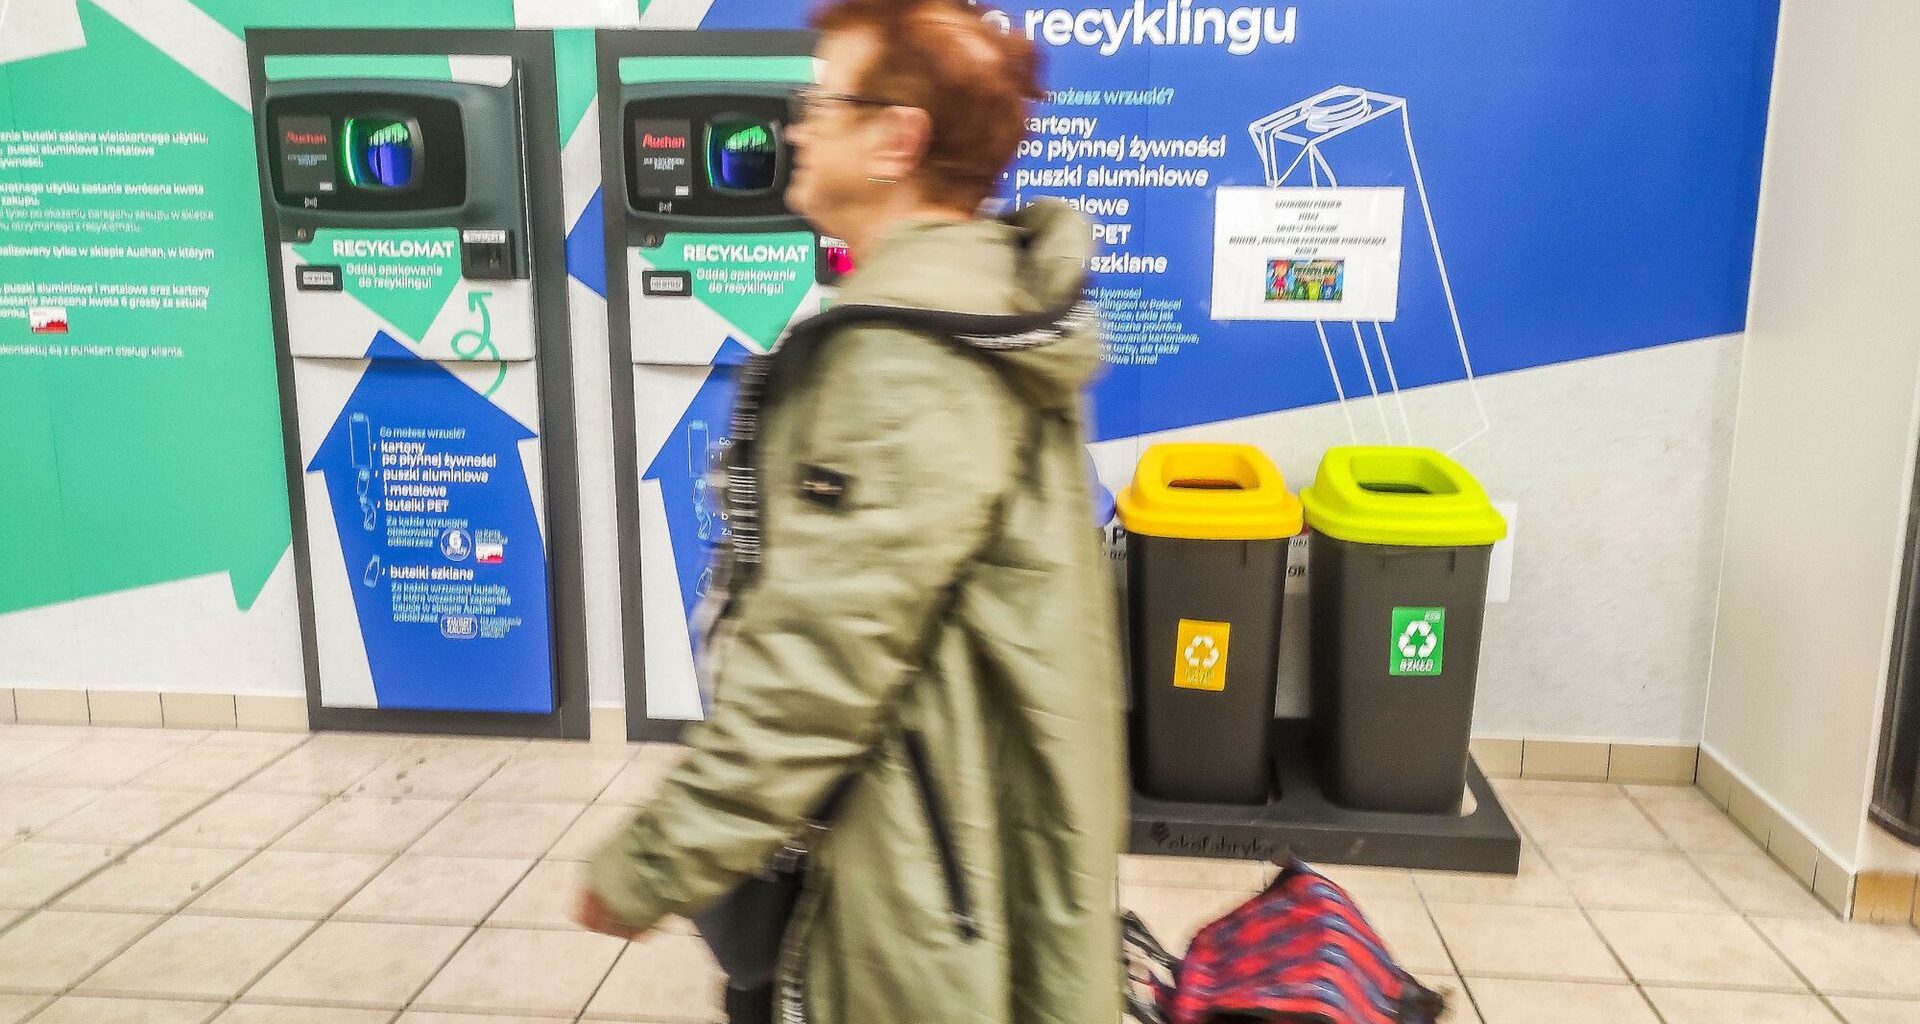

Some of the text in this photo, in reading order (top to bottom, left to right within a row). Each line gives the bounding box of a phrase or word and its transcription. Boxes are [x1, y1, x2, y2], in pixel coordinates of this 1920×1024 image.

[1025, 0, 1298, 56] recyklingu
[1103, 87, 1175, 106] wrzucić?
[642, 133, 686, 149] Auchan
[1016, 134, 1227, 162] po płynnej żywności
[1016, 163, 1210, 190] puszki aluminiowe
[1091, 223, 1131, 245] PET
[333, 239, 455, 259] RECYKLOMAT
[683, 244, 809, 263] RECYKLOMAT
[378, 262, 443, 278] opakowanie
[1090, 252, 1168, 274] szklane
[696, 267, 796, 284] Oddaj opakowanie
[708, 280, 723, 294] do
[381, 440, 426, 456] kartony
[399, 452, 442, 470] płynnej
[443, 452, 497, 469] żywności
[383, 467, 490, 484] puszki aluminiowe
[390, 483, 448, 498] metalowe
[385, 498, 450, 514] butelki PET
[390, 564, 474, 581] butelki szklane
